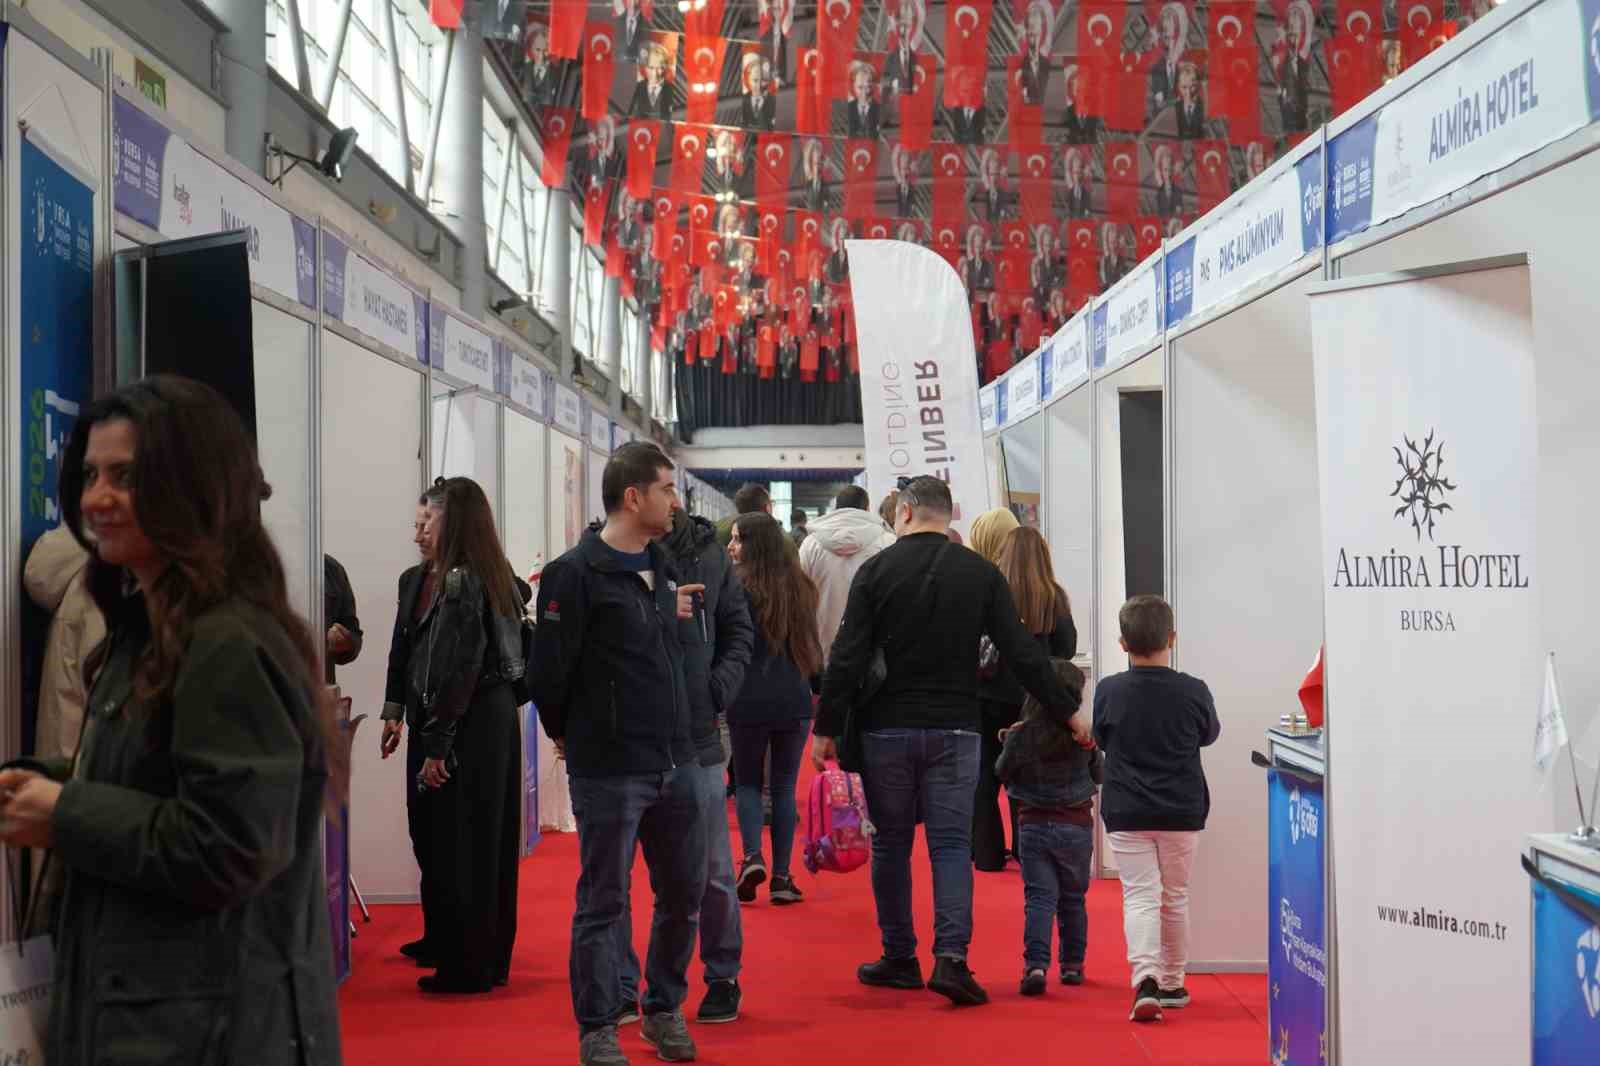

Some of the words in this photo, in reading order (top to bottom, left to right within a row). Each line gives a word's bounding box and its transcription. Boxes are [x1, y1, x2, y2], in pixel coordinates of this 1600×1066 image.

[1428, 87, 1482, 164] ALMİRA
[1486, 57, 1538, 133] HOTEL
[1333, 547, 1432, 588] ALMİRA
[1437, 545, 1529, 588] HOTEL
[1400, 610, 1457, 632] BURSA
[1377, 905, 1507, 941] www.almira.com.tr
